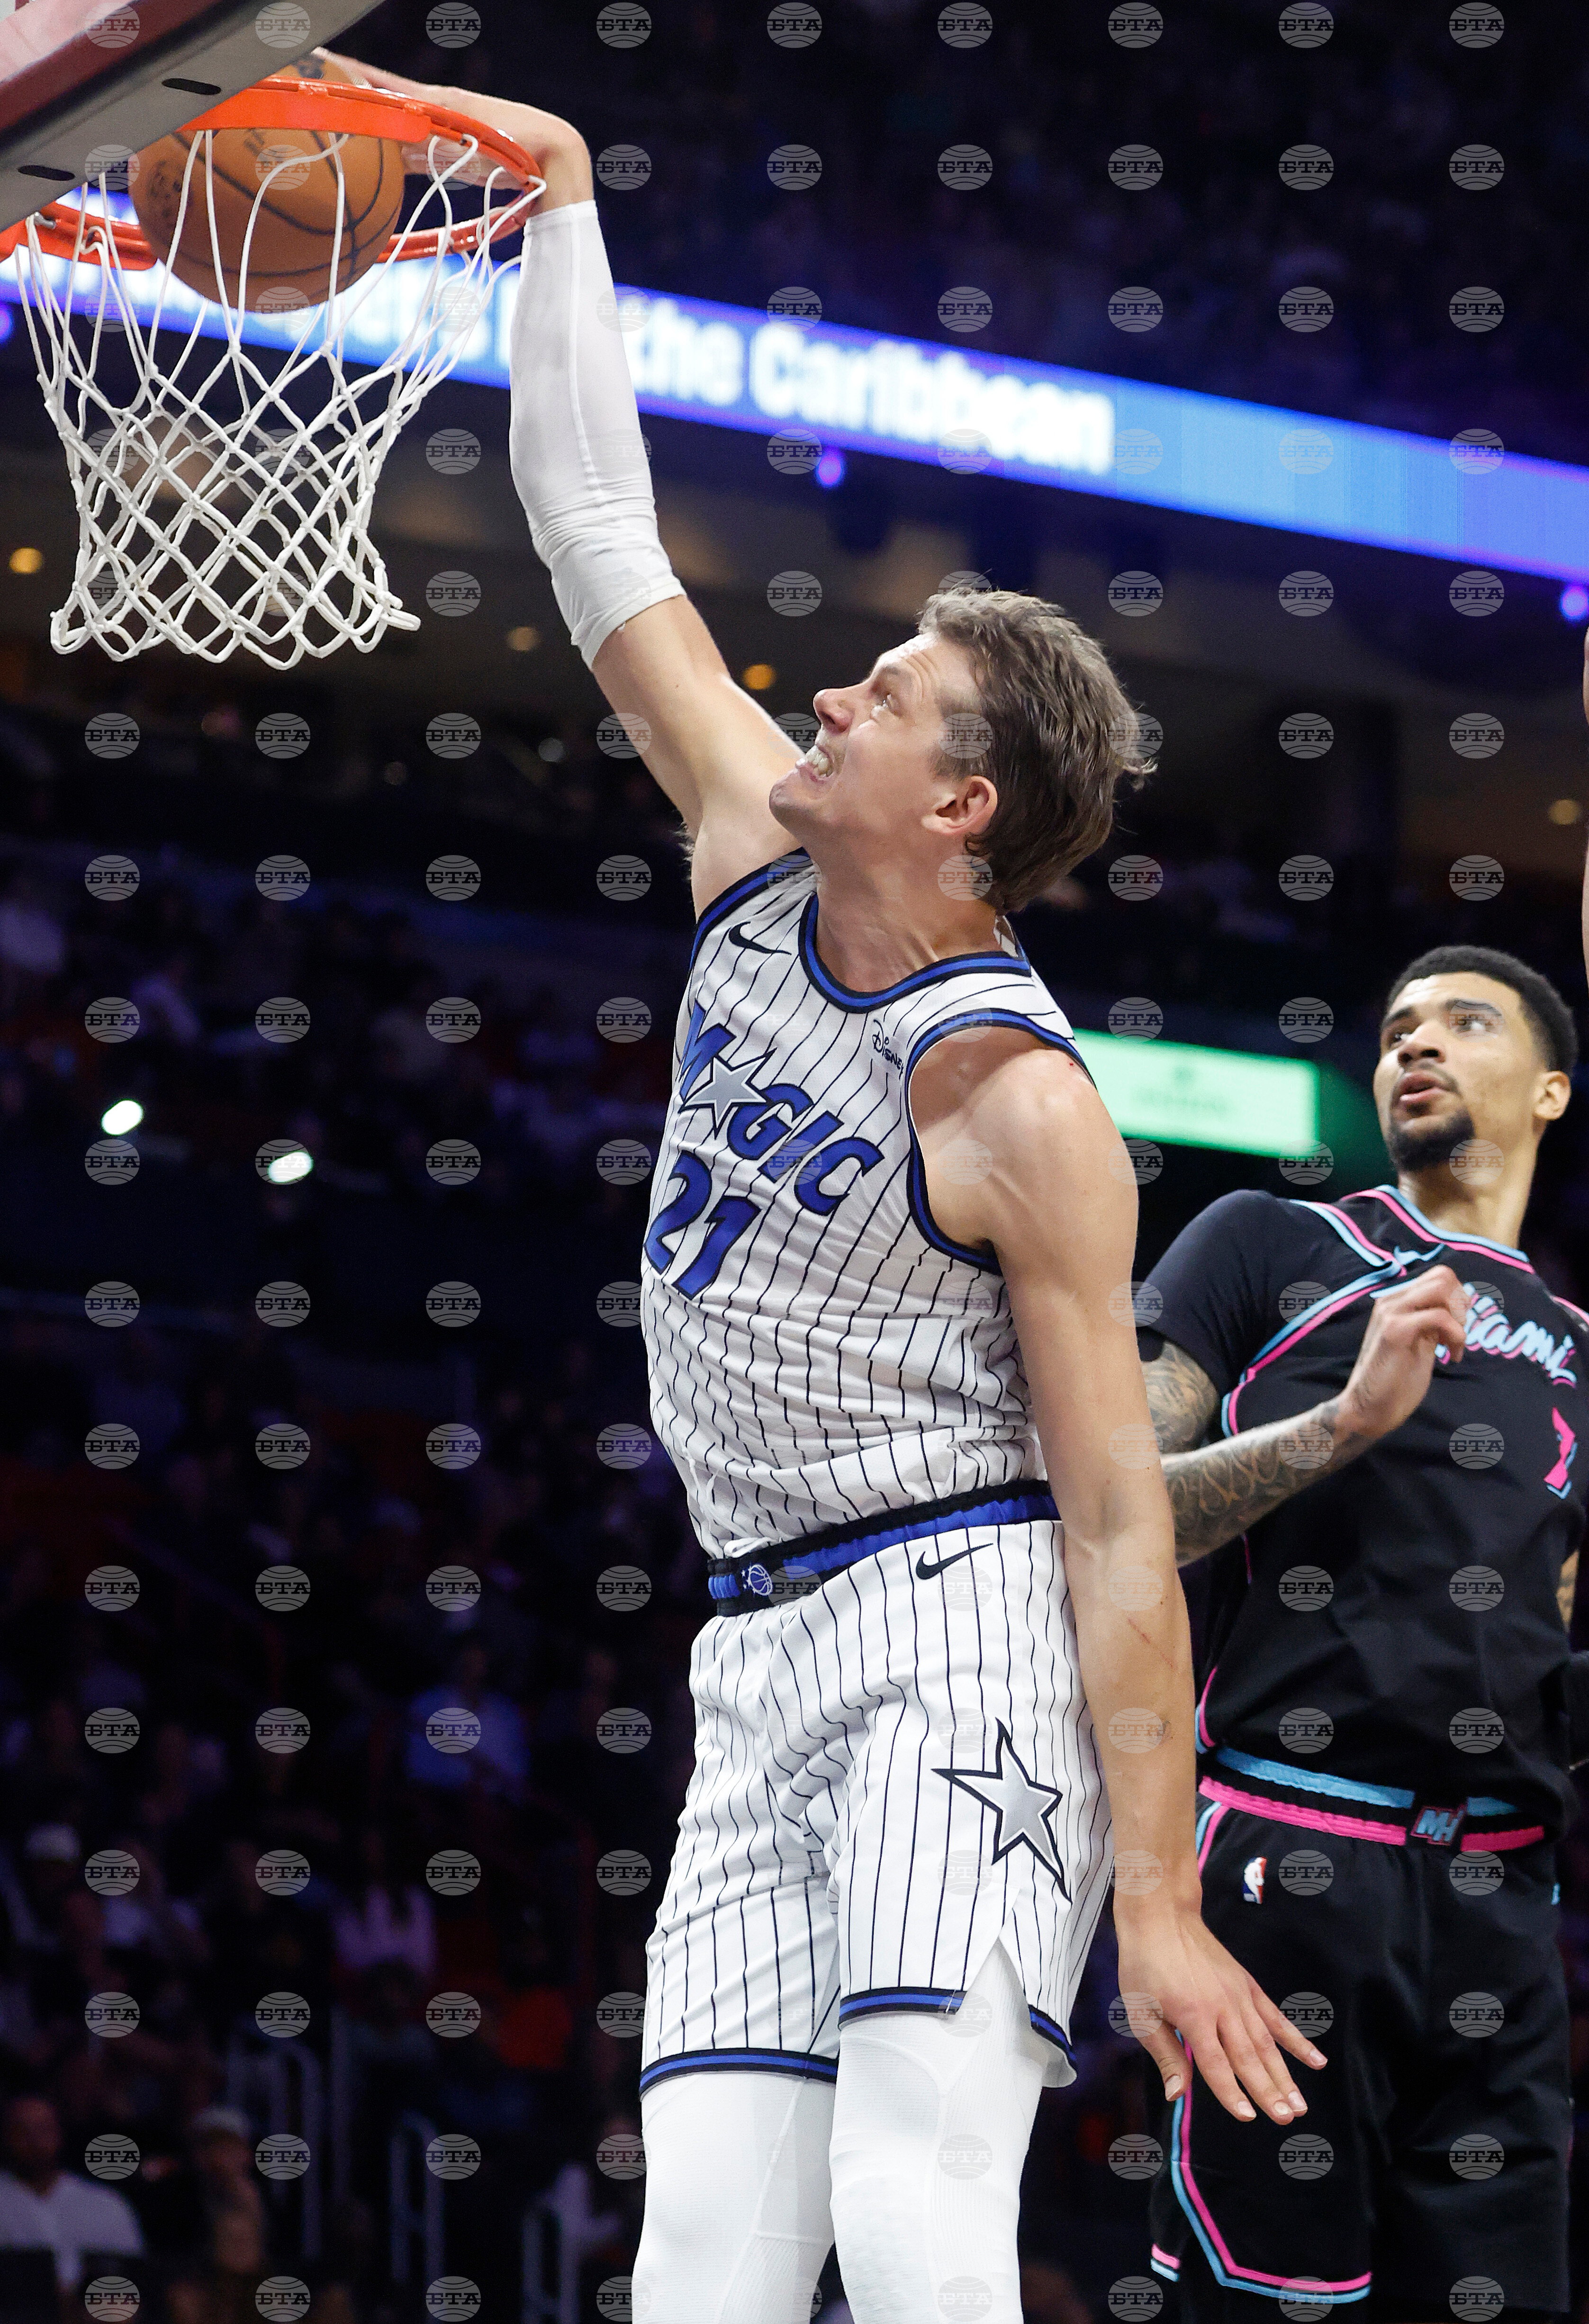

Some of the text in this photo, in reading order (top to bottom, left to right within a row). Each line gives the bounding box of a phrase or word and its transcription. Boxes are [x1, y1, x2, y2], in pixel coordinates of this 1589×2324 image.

[677, 998, 885, 1216] MGIC
[643, 1151, 762, 1300] 21
[1435, 1282, 1577, 1388] iami
